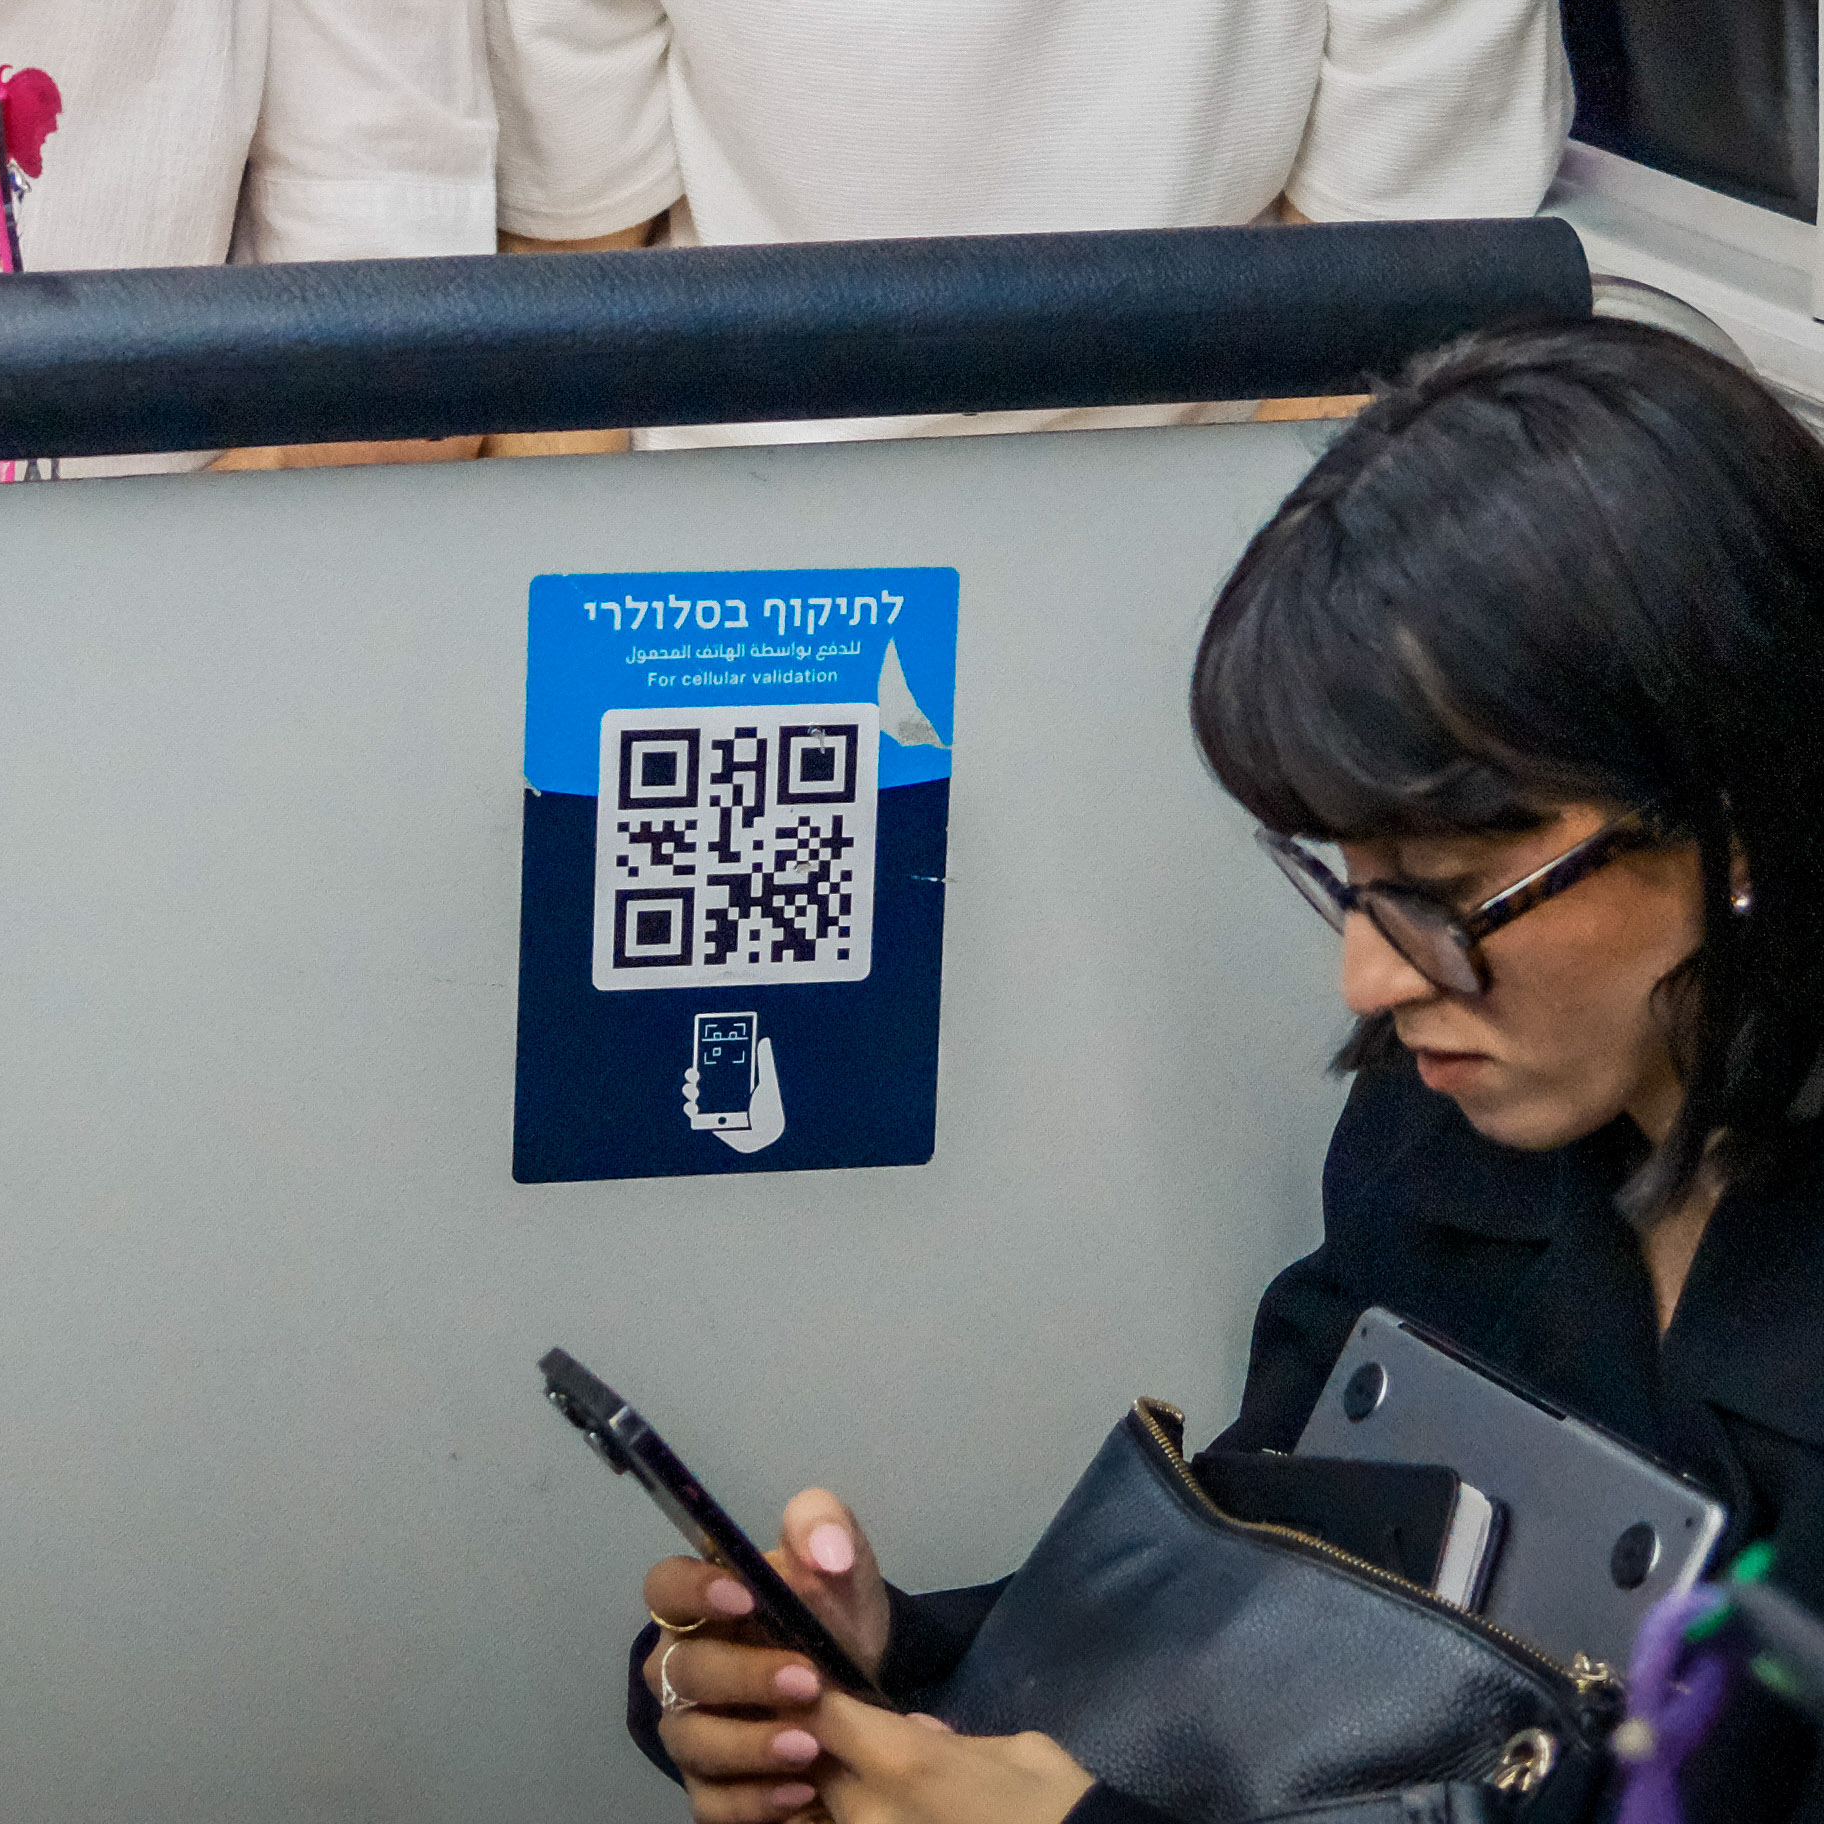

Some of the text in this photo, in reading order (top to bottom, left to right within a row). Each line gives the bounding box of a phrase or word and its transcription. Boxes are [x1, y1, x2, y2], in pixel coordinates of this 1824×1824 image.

[583, 589, 904, 635] לתיקוף בסלולרי
[625, 641, 862, 664] للدفع بواسطة الهاتف المحمول
[648, 669, 838, 687] For cellular validation
